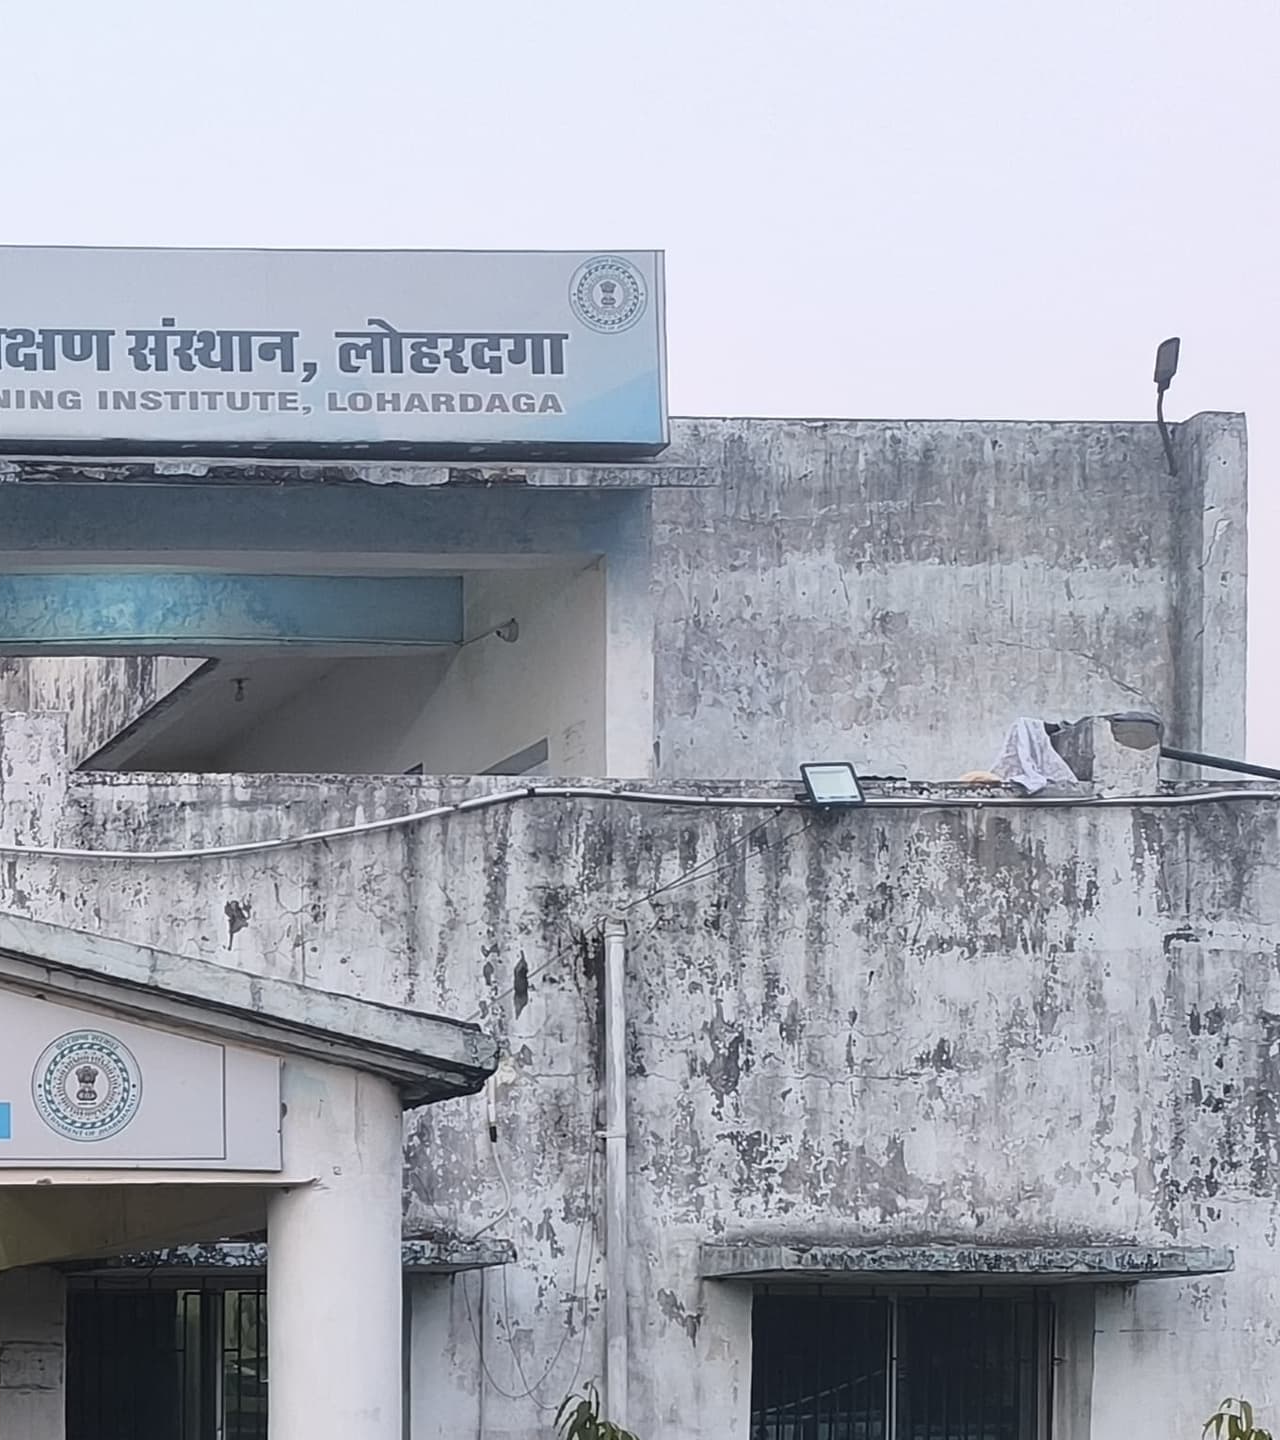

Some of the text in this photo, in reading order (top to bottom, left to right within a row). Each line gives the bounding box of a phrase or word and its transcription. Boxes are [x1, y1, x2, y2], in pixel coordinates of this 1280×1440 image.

[126, 318, 316, 383] संस्थान,
[335, 318, 568, 375] लोहरदगा
[98, 390, 311, 415] INSTITUTE,
[327, 392, 563, 413] LOHARDAGA
